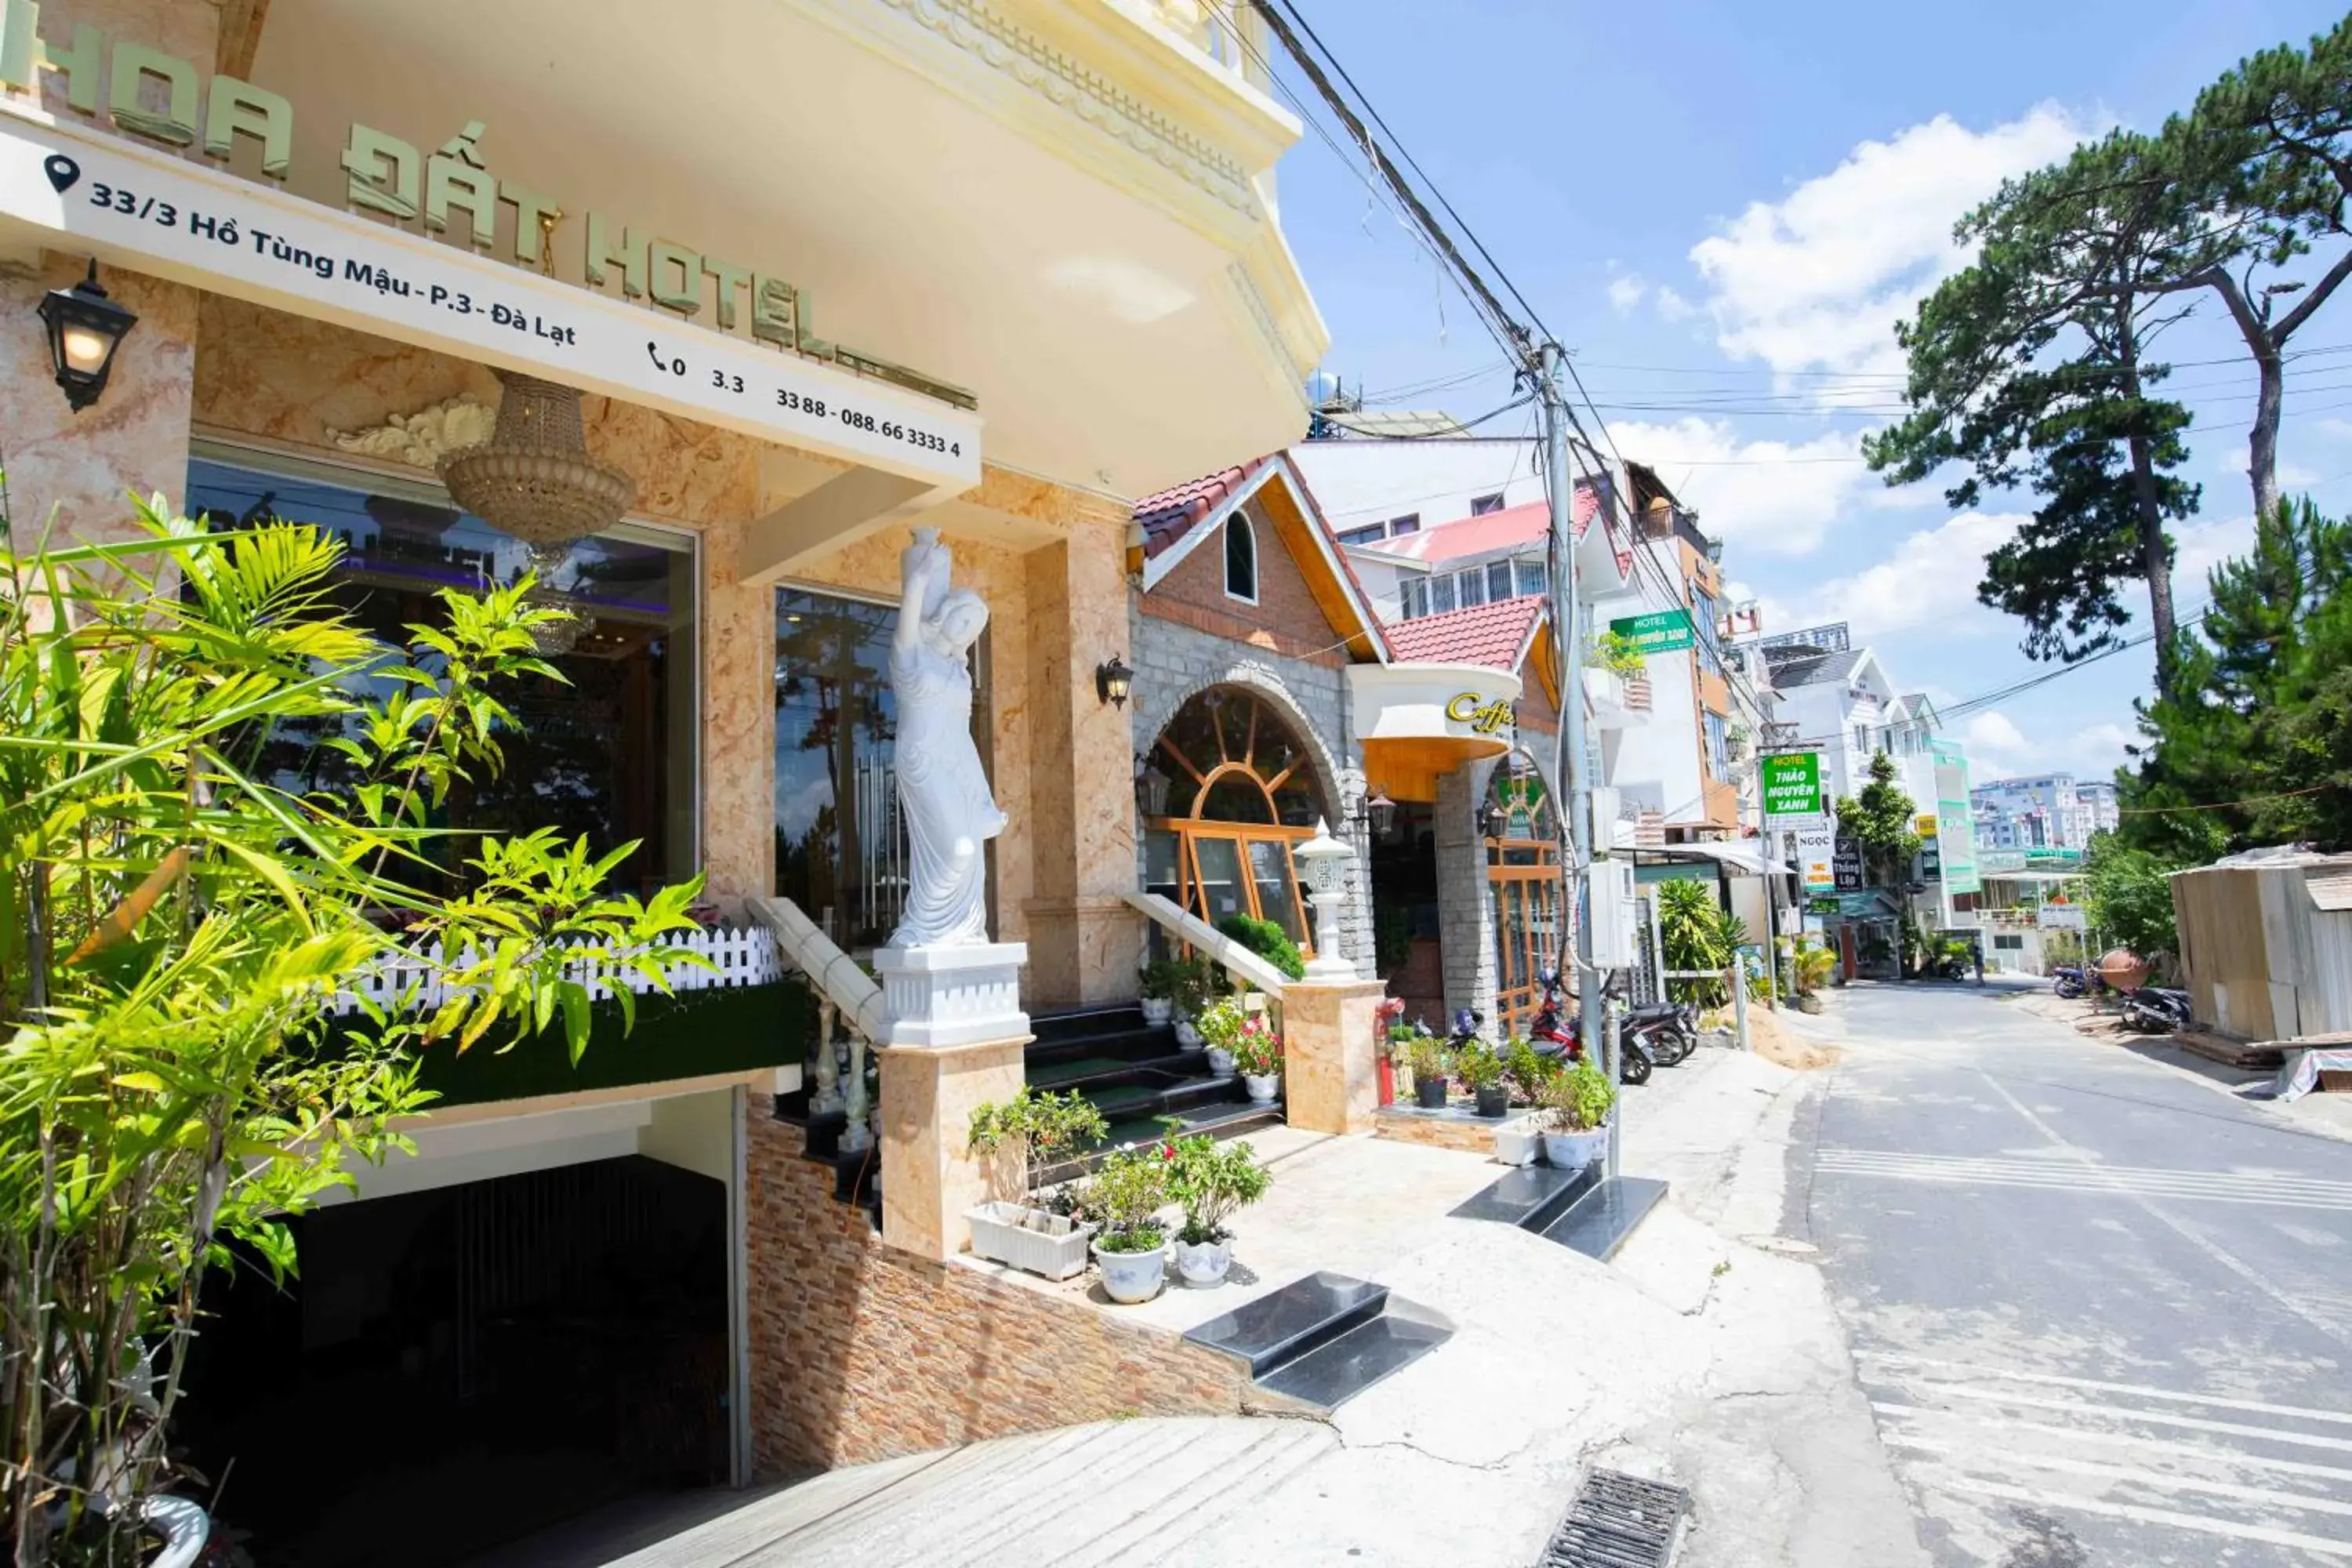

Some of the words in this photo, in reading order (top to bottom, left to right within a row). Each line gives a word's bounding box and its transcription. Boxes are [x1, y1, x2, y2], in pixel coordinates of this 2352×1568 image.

[1, 0, 293, 181] HOA
[340, 120, 560, 263] ĐẤT
[585, 210, 833, 361] HOTEL
[89, 182, 177, 227] 33/3
[190, 212, 239, 245] Hồ
[250, 229, 334, 279] Tùng
[535, 316, 575, 347] Lạt
[1635, 615, 1667, 628] HOTEL
[1773, 756, 1806, 766] HOTEL
[1775, 768, 1806, 783] THẢO
[1768, 782, 1815, 797] NGUYÊN
[1776, 799, 1809, 811] XANH
[1799, 836, 1831, 847] NGỌC
